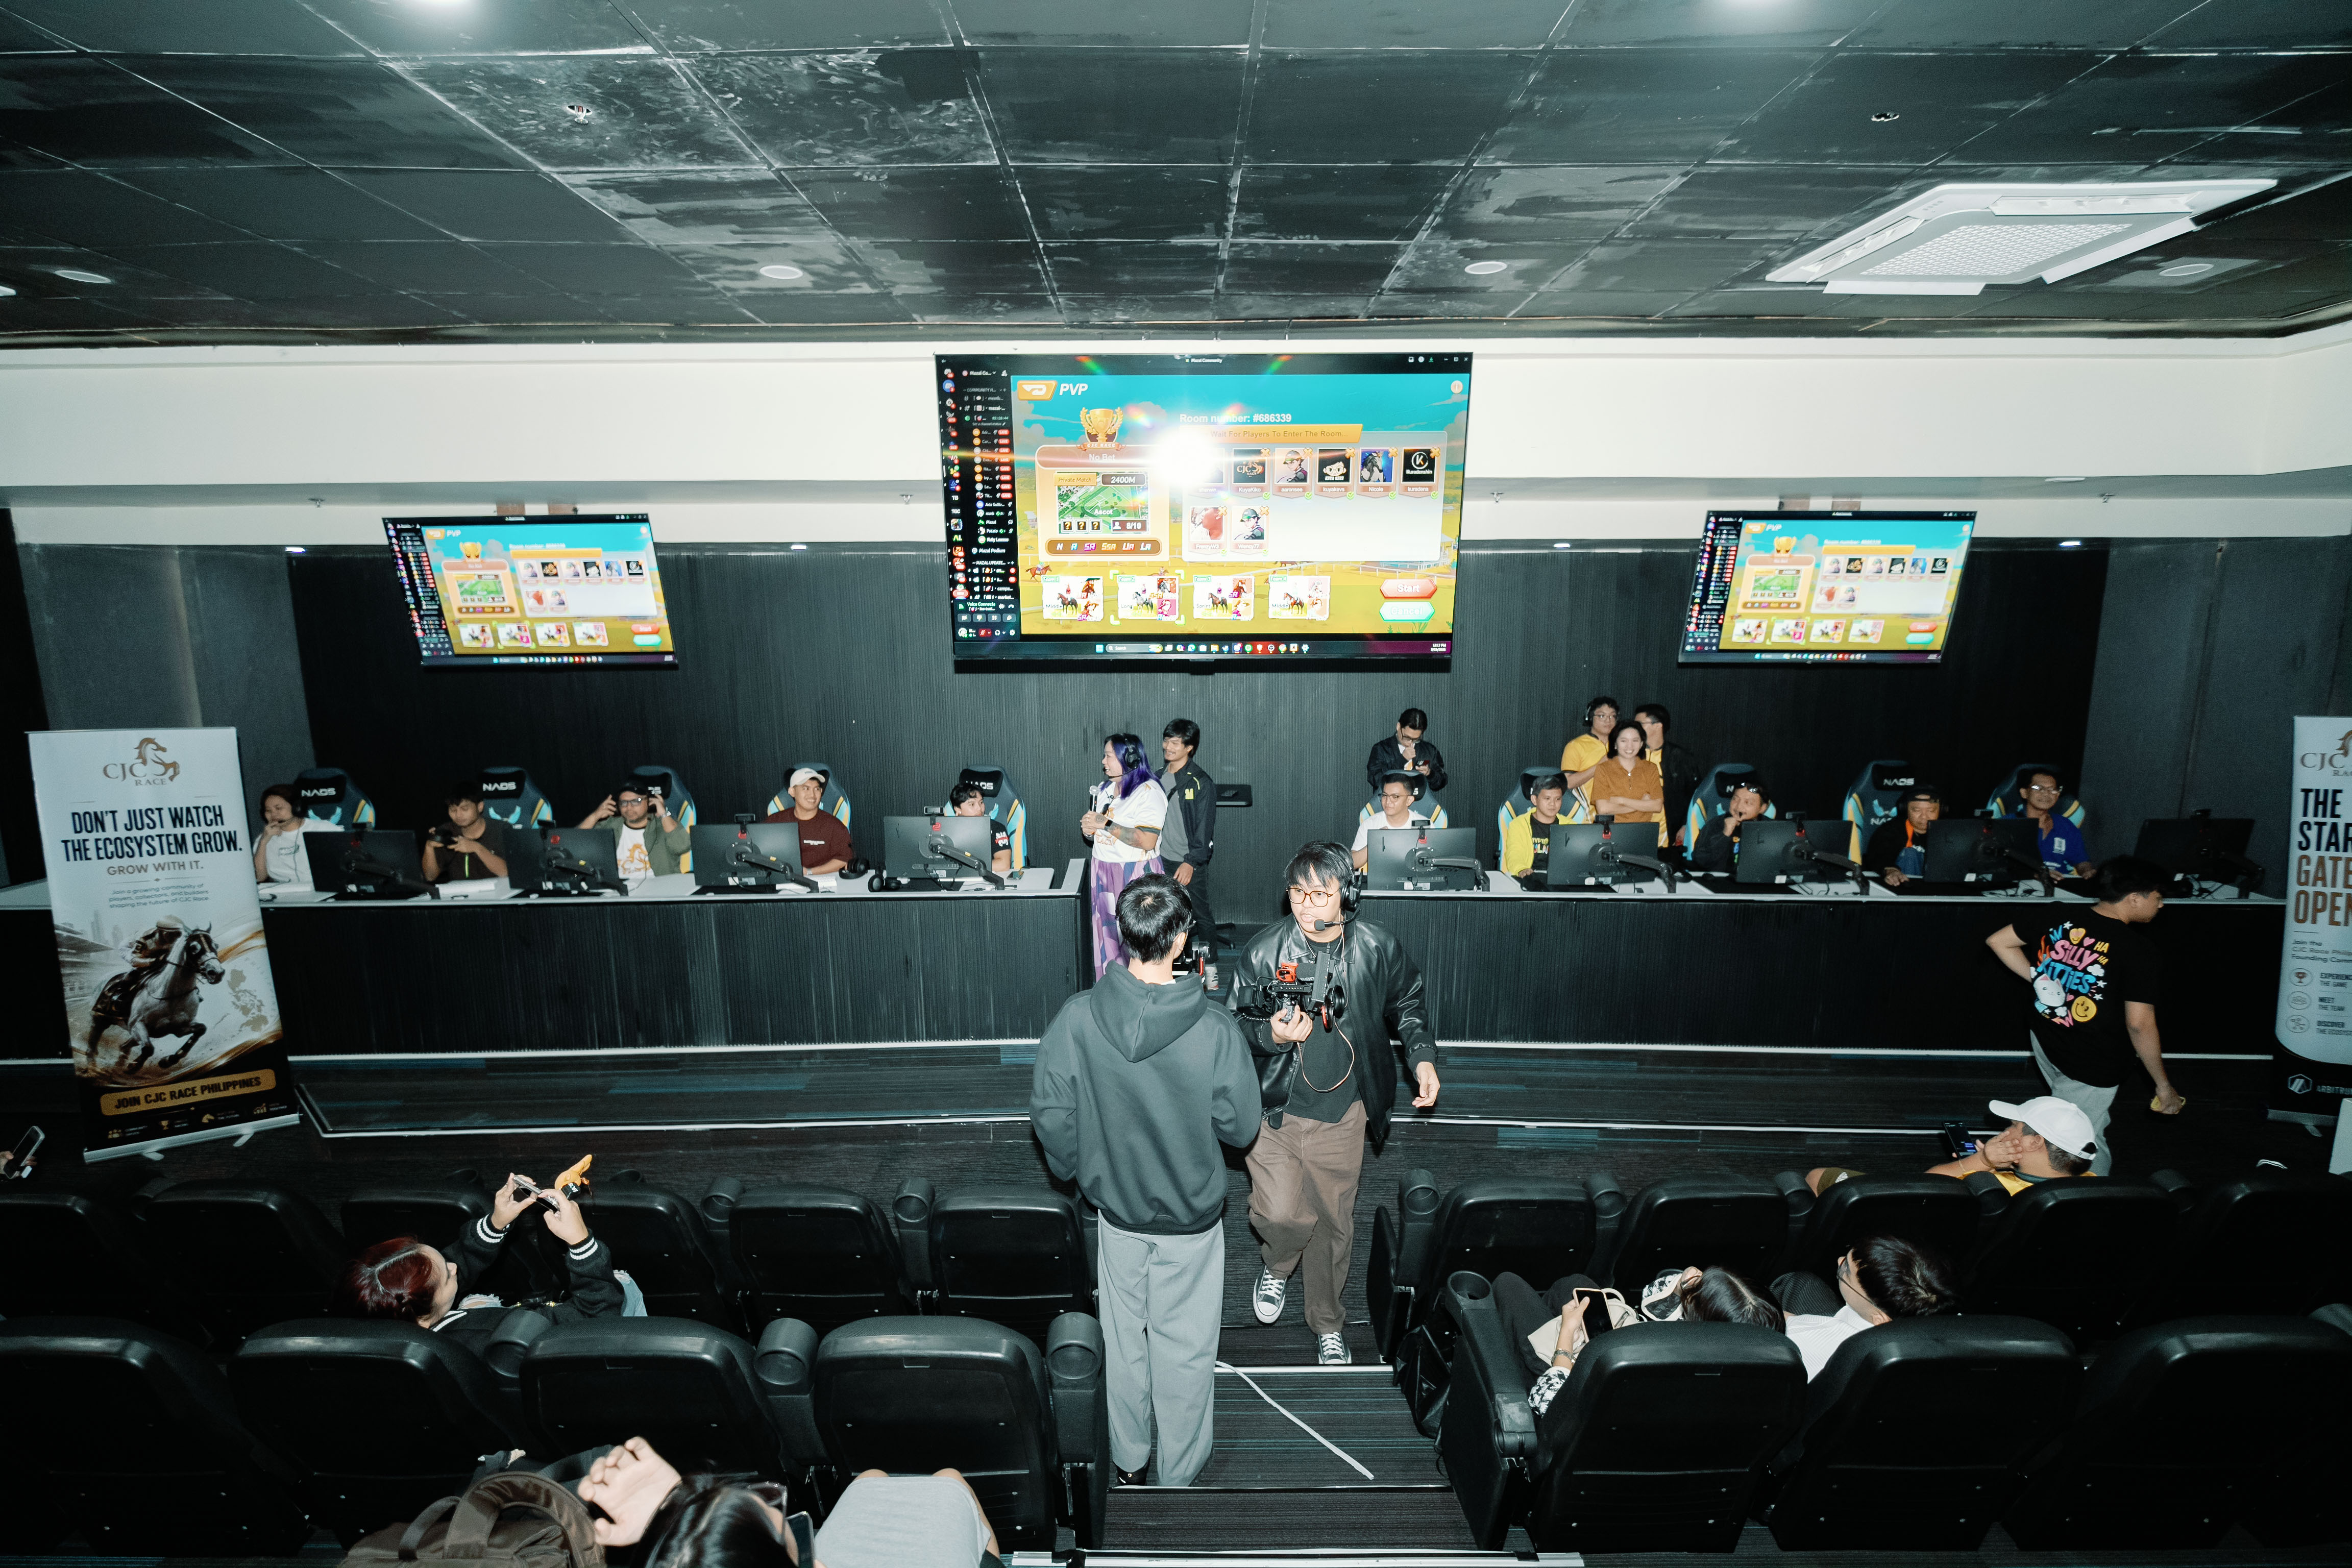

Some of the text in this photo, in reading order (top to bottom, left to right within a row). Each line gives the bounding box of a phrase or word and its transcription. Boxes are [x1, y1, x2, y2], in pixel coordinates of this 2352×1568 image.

[1060, 383, 1088, 396] PVP
[1179, 413, 1292, 423] Room number: #686339
[1243, 431, 1269, 439] Players
[1089, 453, 1115, 461] No Bet
[1126, 522, 1142, 530] 8/10
[1084, 543, 1096, 551] SR
[1101, 543, 1117, 551] SSR
[1396, 583, 1420, 593] Start
[1391, 606, 1423, 616] Cancel
[482, 781, 517, 791] NAOS
[1883, 778, 1915, 786] NAOS
[301, 788, 336, 797] NAOS
[2301, 788, 2343, 819] THE
[71, 805, 224, 834] DON'T JUST WATCH
[61, 830, 243, 862] THE ECOSYSTEM GROW.
[107, 860, 204, 876] GROW WITH IT.
[2093, 941, 2110, 953] HA
[2098, 955, 2109, 965] HA
[2291, 953, 2328, 963] Founding
[114, 1076, 261, 1109] JOIN CJC RACE PHILIPPINES
